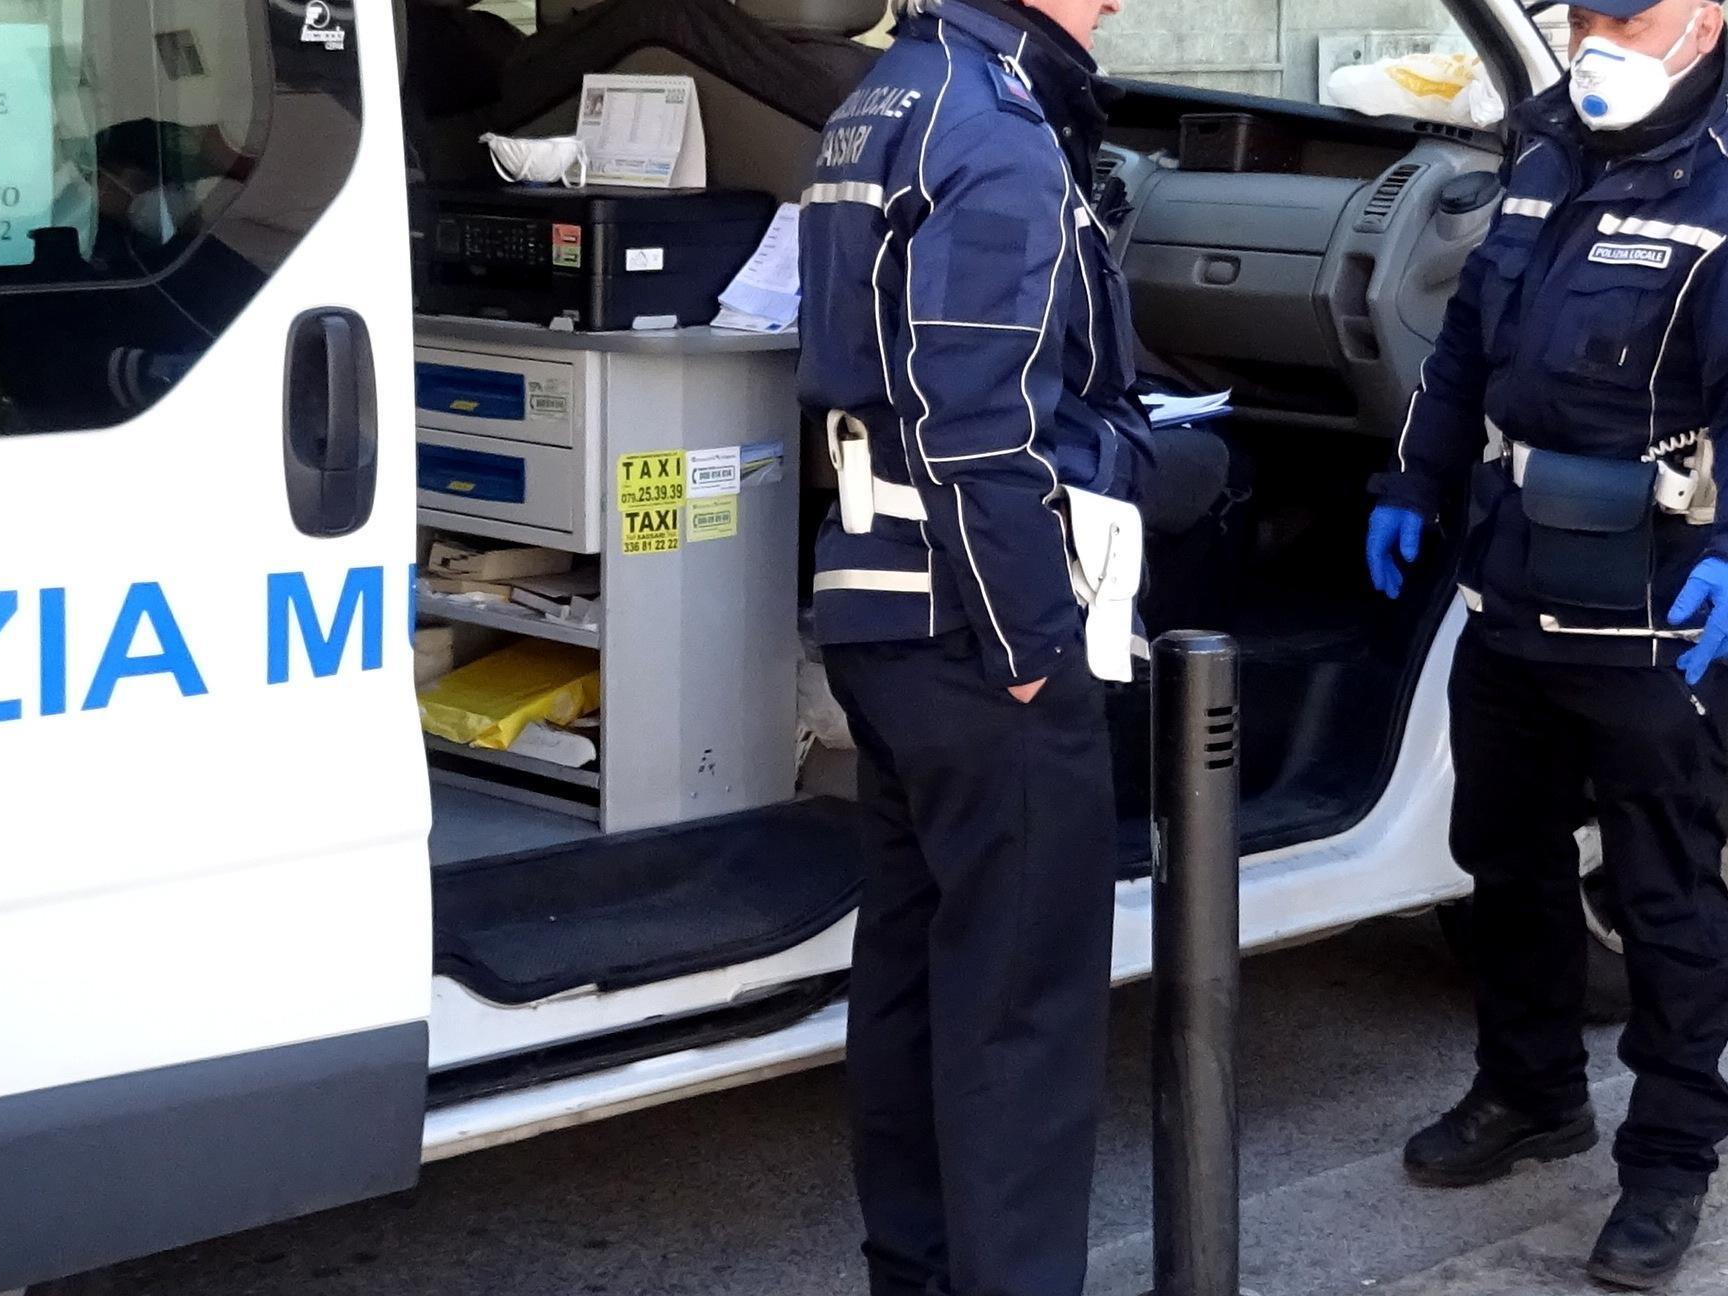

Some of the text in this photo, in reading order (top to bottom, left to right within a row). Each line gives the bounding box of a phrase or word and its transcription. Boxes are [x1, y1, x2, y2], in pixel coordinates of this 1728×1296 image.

[1595, 247, 1663, 262] POLIZIA LOCALE
[622, 457, 681, 480] TAXI
[625, 508, 677, 533] TAXI
